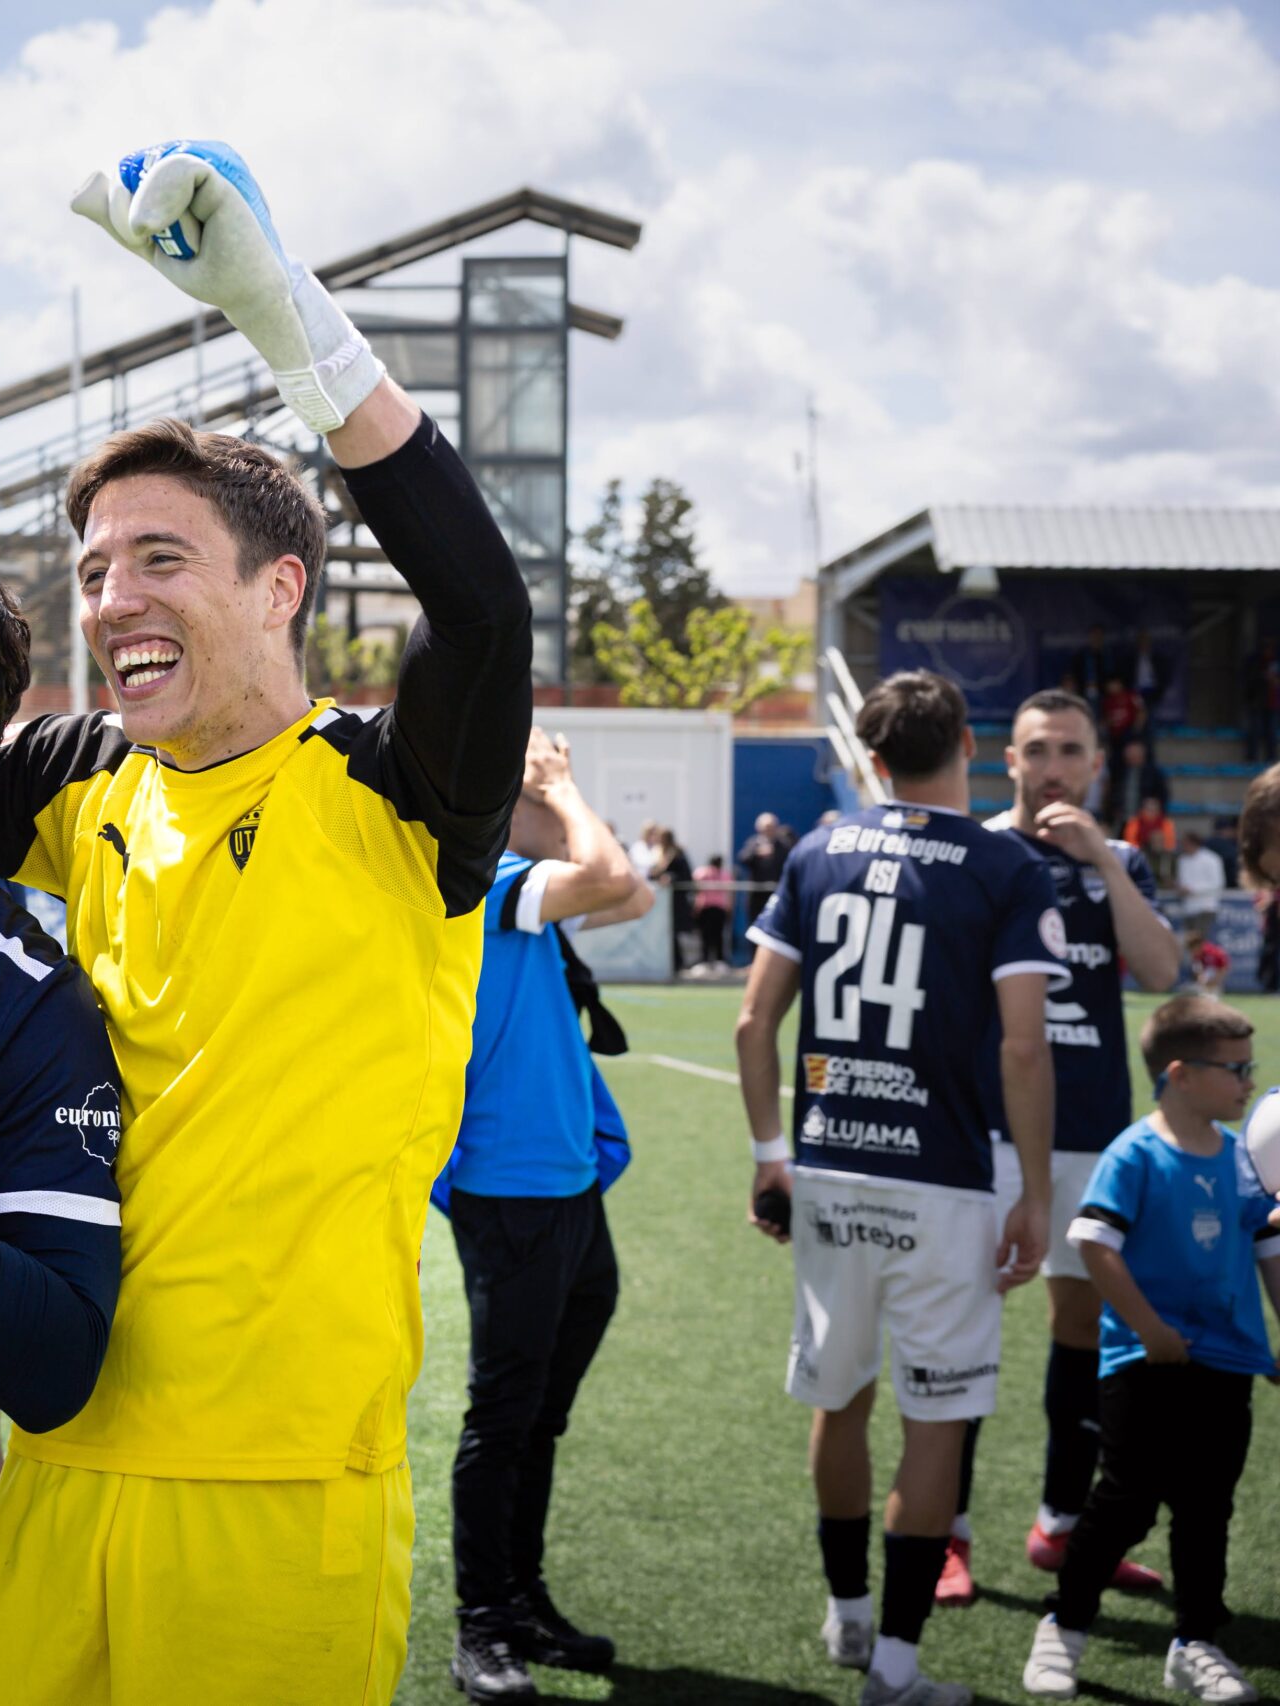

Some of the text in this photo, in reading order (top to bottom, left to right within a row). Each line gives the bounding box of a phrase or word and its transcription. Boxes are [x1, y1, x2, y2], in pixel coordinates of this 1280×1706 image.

[863, 859, 902, 894] ISI
[814, 892, 926, 1050] 24
[826, 1075, 850, 1095] DE
[826, 1117, 920, 1150] LUJAMA
[837, 1222, 916, 1252] Utebo
